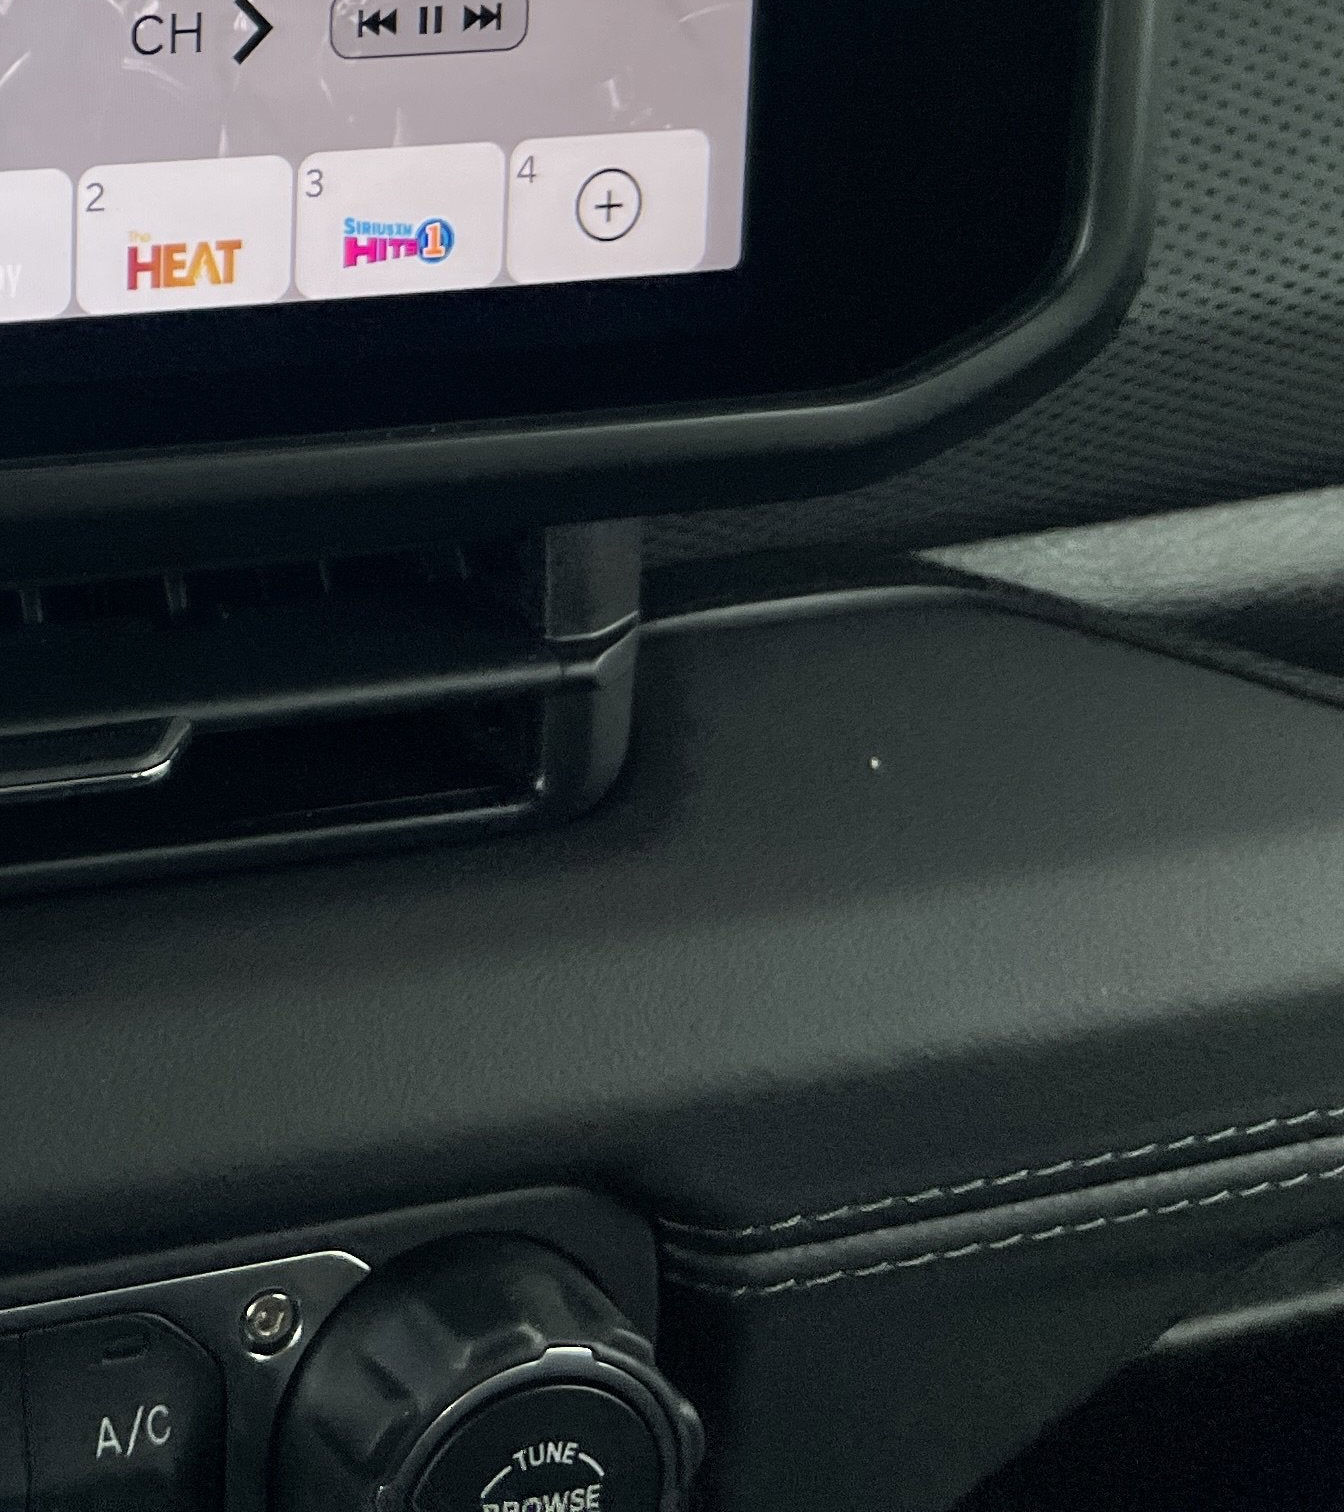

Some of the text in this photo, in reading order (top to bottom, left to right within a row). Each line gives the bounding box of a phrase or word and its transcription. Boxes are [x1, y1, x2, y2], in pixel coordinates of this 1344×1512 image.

[131, 12, 203, 56] CH
[304, 168, 324, 198] 3
[516, 155, 537, 184] 4
[85, 182, 106, 213] 2
[126, 238, 243, 291] HEAT
[344, 237, 418, 268] HITS
[96, 1404, 172, 1458] A/C
[512, 1441, 579, 1471] TUNE
